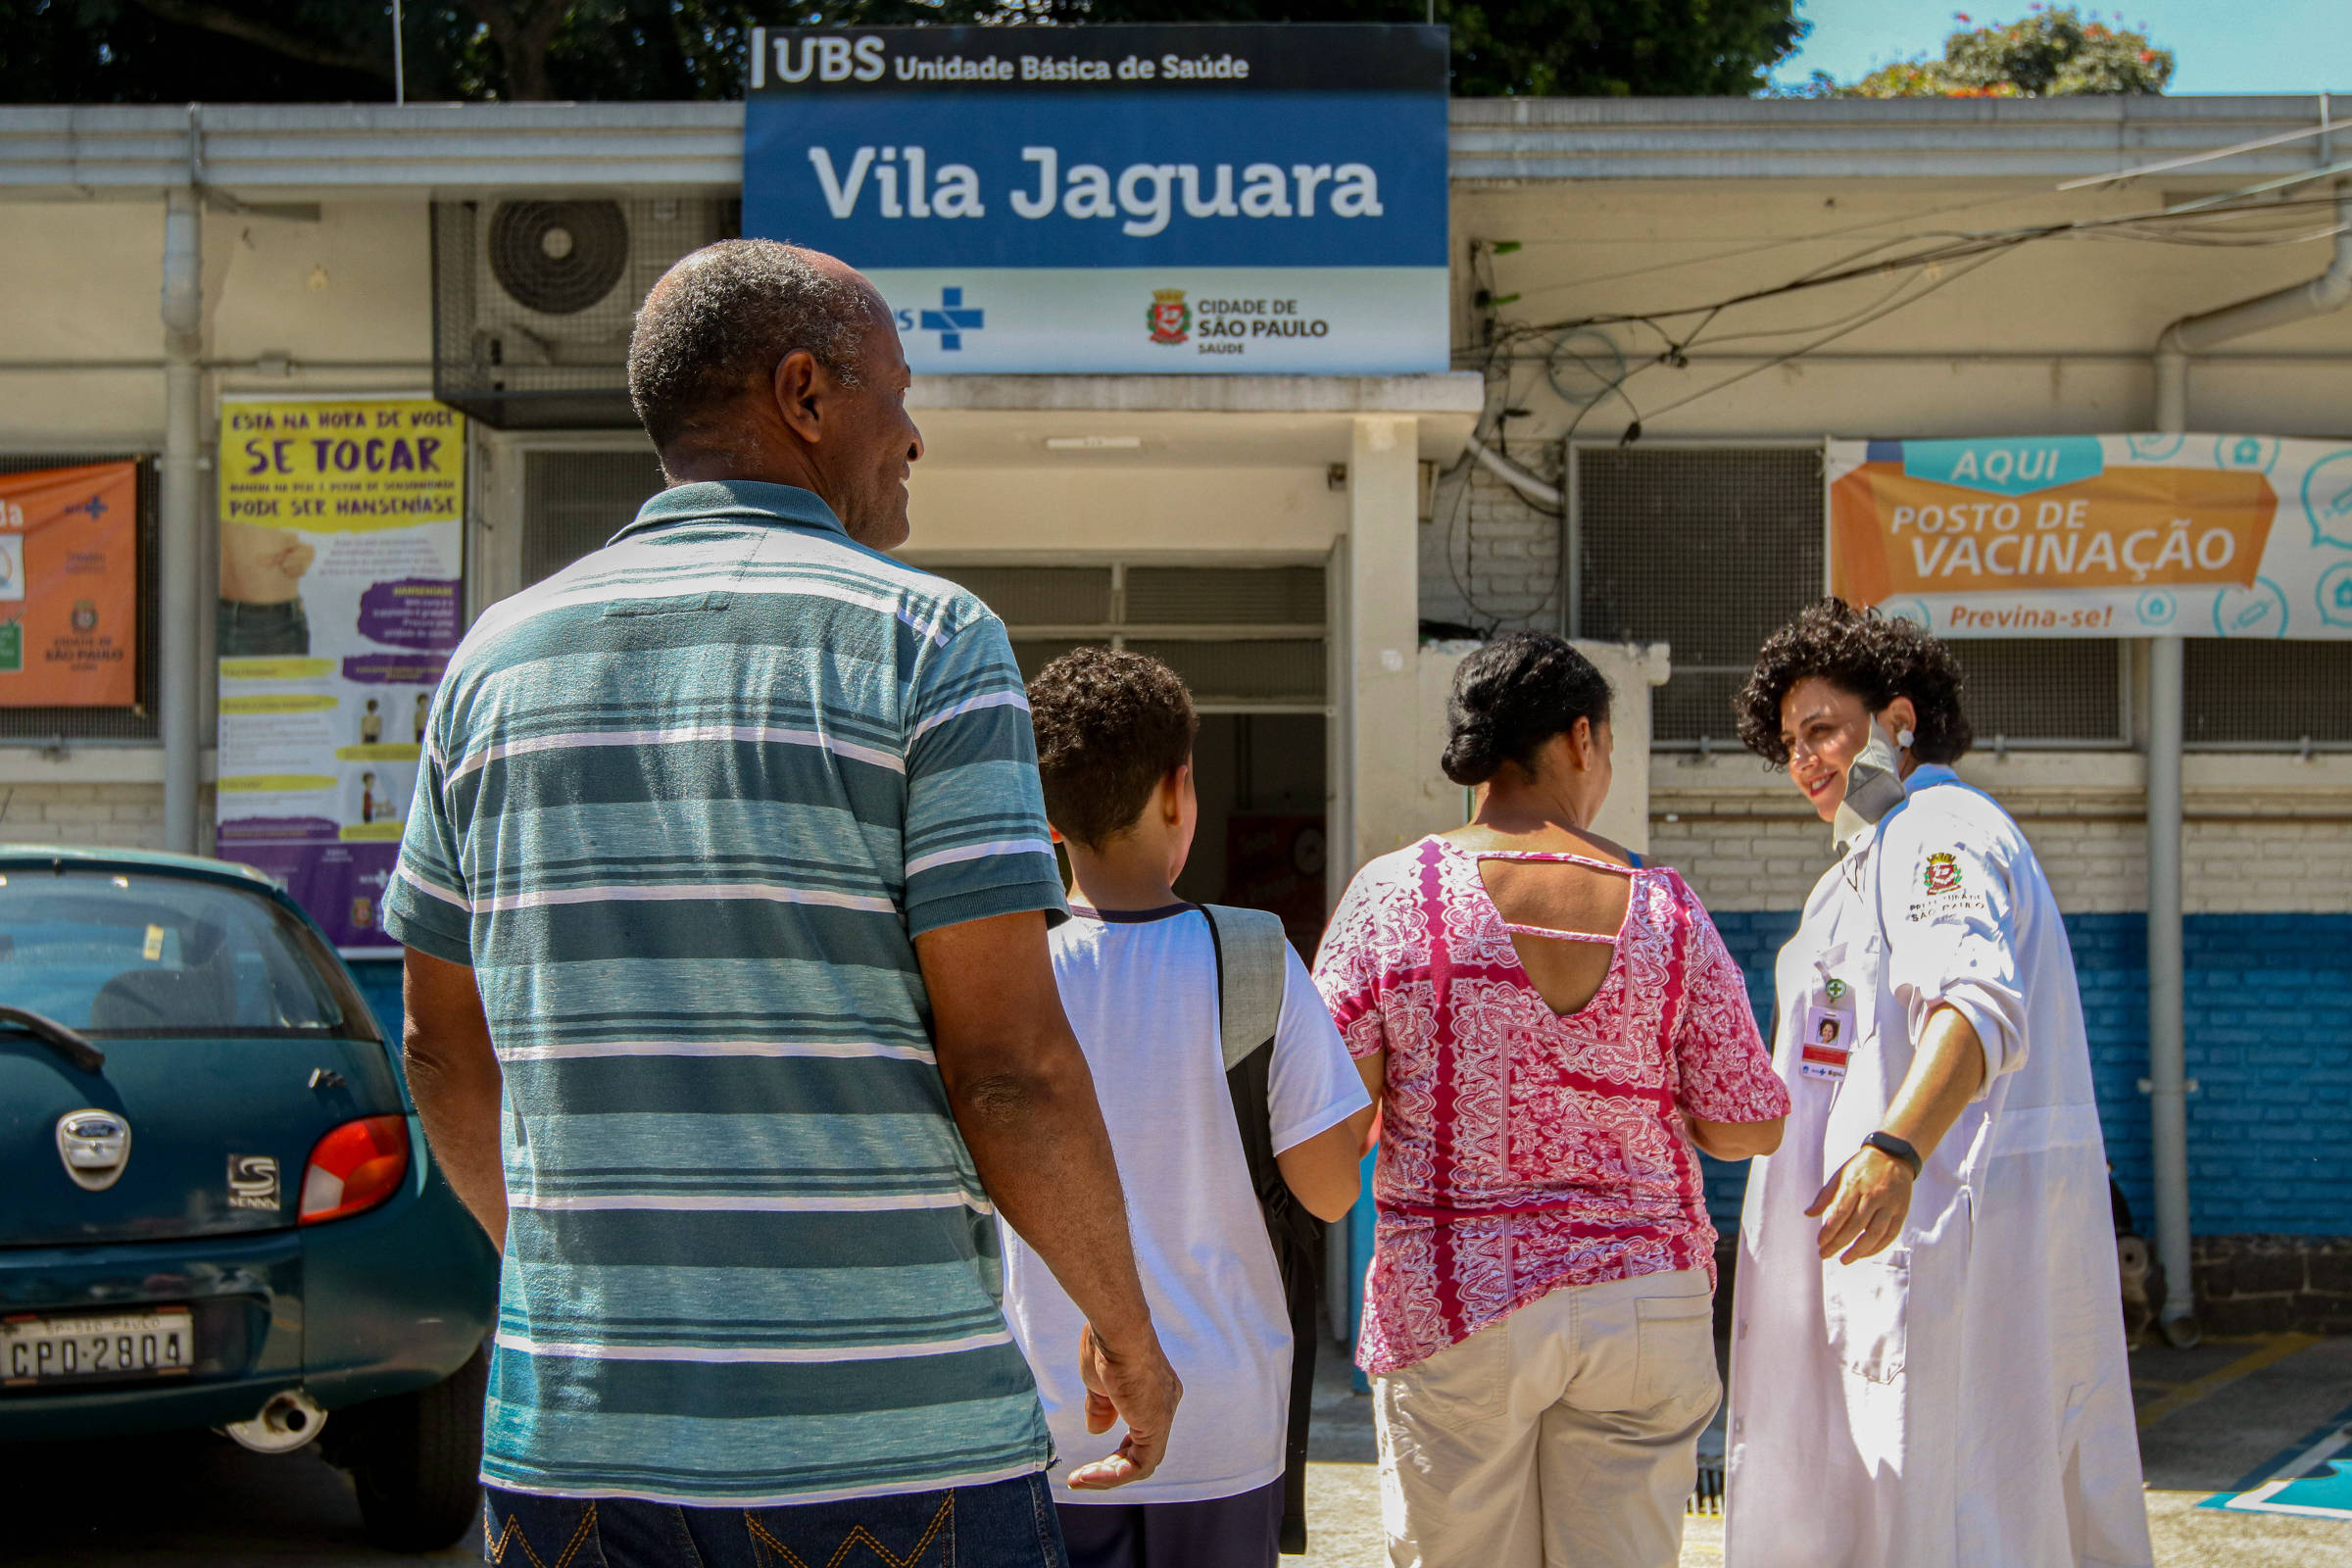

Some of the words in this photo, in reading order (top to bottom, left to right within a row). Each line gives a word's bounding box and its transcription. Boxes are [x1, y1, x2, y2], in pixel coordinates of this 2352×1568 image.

[772, 35, 886, 82] UBS
[895, 54, 1014, 80] Unidade
[1019, 55, 1111, 80] Básica
[1117, 55, 1155, 79] de
[1161, 54, 1250, 79] Saúde
[808, 145, 986, 220] Vila
[1009, 145, 1384, 238] Jaguara
[1198, 299, 1268, 315] CIDADE
[1273, 299, 1298, 315] DE
[1198, 316, 1247, 337] SÃO
[1251, 319, 1329, 337] PAULO
[1198, 341, 1245, 354] SAÚDE
[232, 409, 275, 429] ESTÁ
[282, 412, 310, 429] NA
[318, 410, 367, 428] HORA
[376, 410, 402, 427] DE
[245, 437, 293, 474] SE
[311, 437, 441, 473] TOCAR
[1950, 450, 2060, 485] AQUI
[229, 499, 280, 516] PODE
[291, 498, 325, 516] SER
[337, 494, 456, 515] HANSENÍASE
[1890, 502, 2021, 535] POSTO
[2035, 499, 2089, 530] DE
[1911, 518, 2236, 582] VACINAÇÃO
[1949, 605, 2114, 628] Previna-se!
